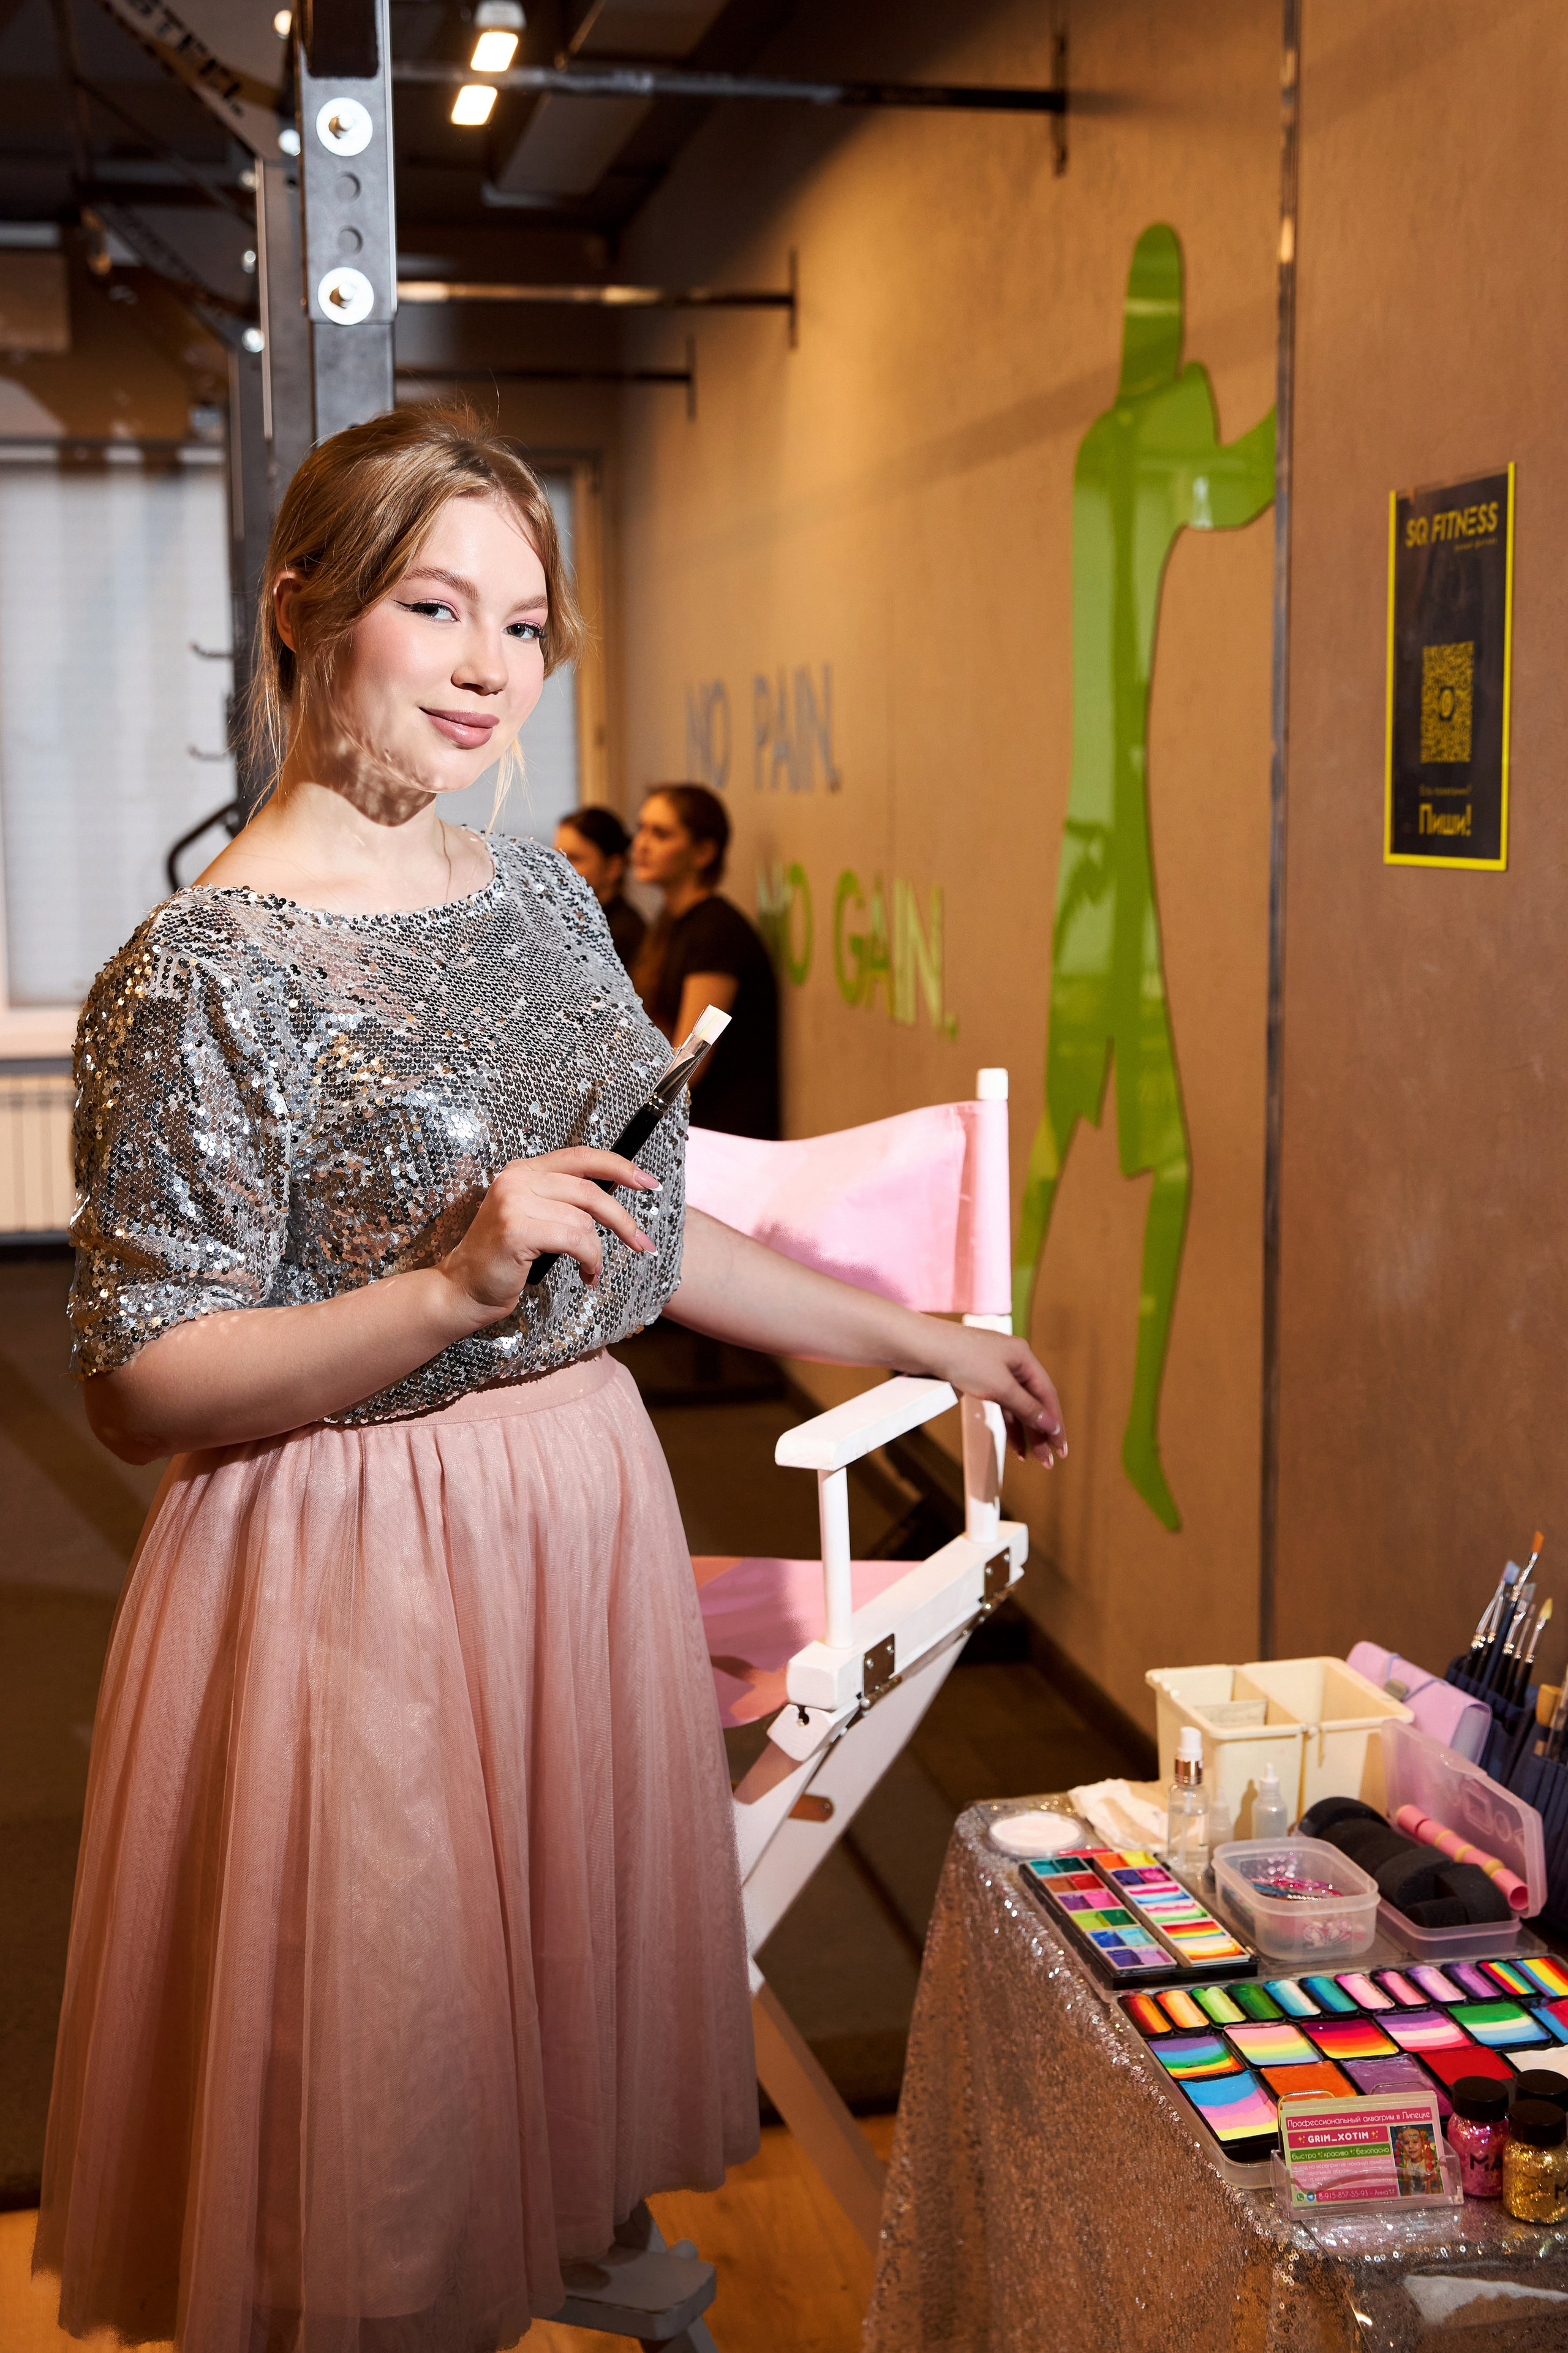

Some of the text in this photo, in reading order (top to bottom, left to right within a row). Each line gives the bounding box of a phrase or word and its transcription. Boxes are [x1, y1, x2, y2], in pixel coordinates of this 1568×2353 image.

[1430, 500, 1499, 543] FITNESS
[685, 678, 732, 791] NO
[1419, 803, 1472, 837] Пиши!
[1287, 2116, 1362, 2129] Профессиональный
[1402, 2111, 1431, 2120] Липецке
[1307, 2131, 1369, 2143] GRIM_XOTIM
[1318, 2189, 1369, 2200] 8-915-857-55-93
